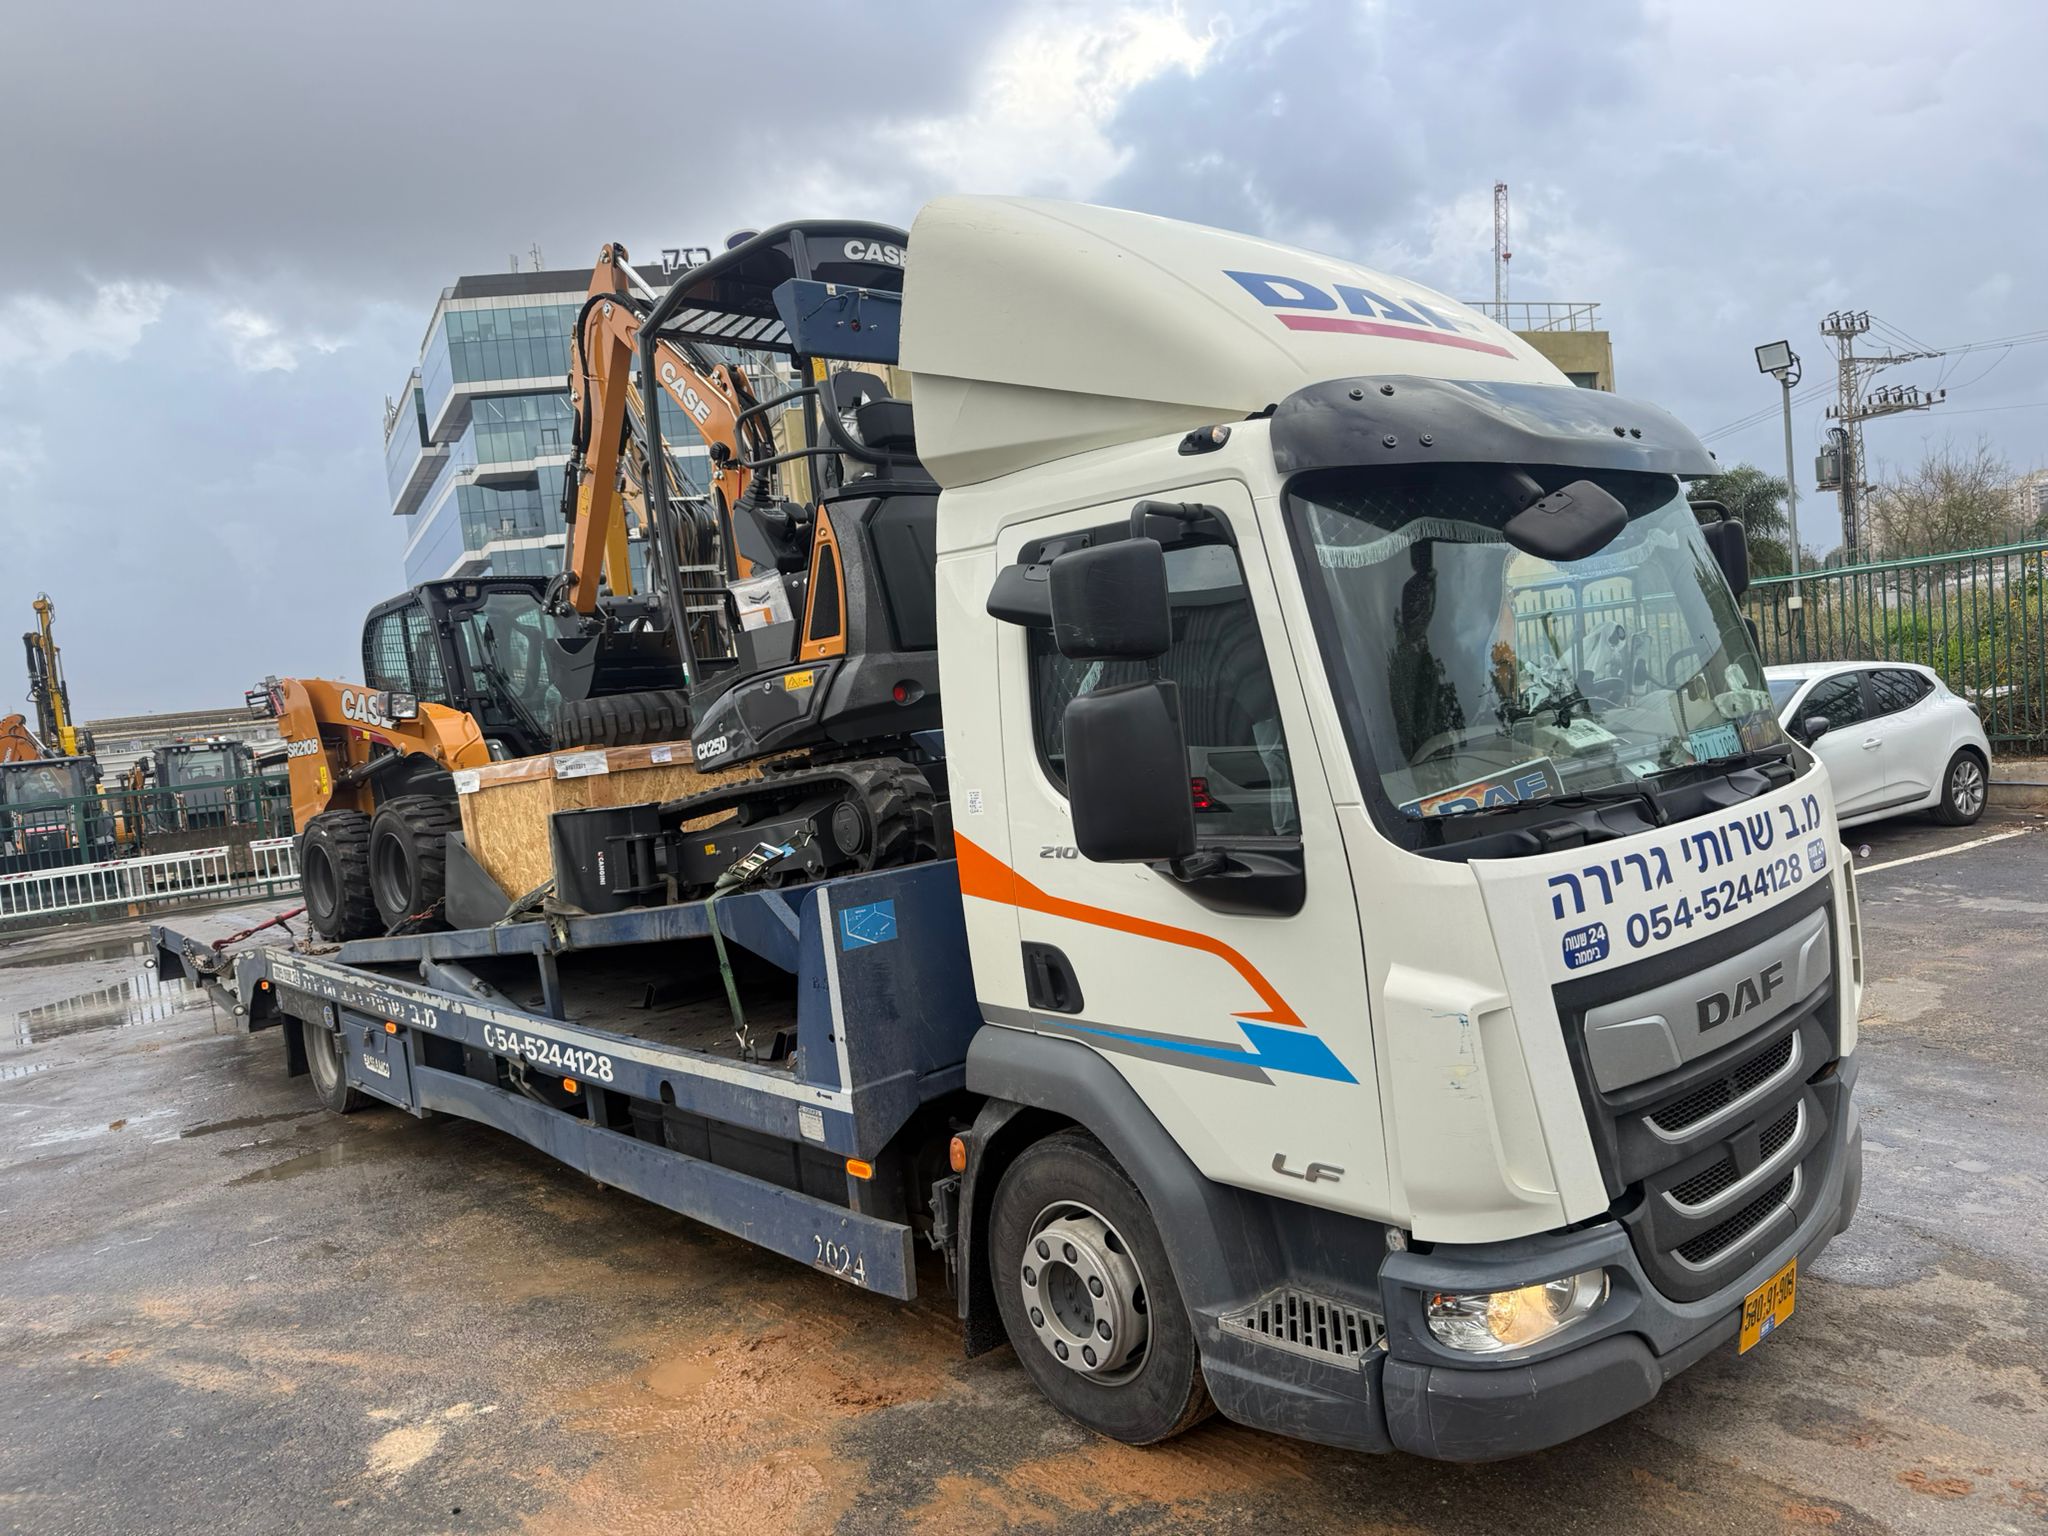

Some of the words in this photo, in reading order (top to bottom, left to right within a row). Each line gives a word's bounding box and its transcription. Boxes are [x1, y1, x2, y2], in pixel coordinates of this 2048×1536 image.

[1221, 270, 1482, 333] DAF
[661, 362, 712, 425] CASE
[341, 689, 394, 730] CAS
[287, 738, 319, 758] SR210B
[1438, 771, 1548, 815] DAF
[1779, 793, 1821, 841] מ.ב
[1039, 846, 1079, 859] 210
[1680, 810, 1774, 873] שרותי
[1548, 846, 1673, 920] גרירה
[1626, 853, 1802, 948] 054-5244128
[1565, 932, 1588, 952] שעות
[1574, 946, 1602, 966] ביממה
[1588, 925, 1606, 945] 24
[1696, 959, 1784, 1035] DAF
[1271, 1152, 1345, 1183] LF
